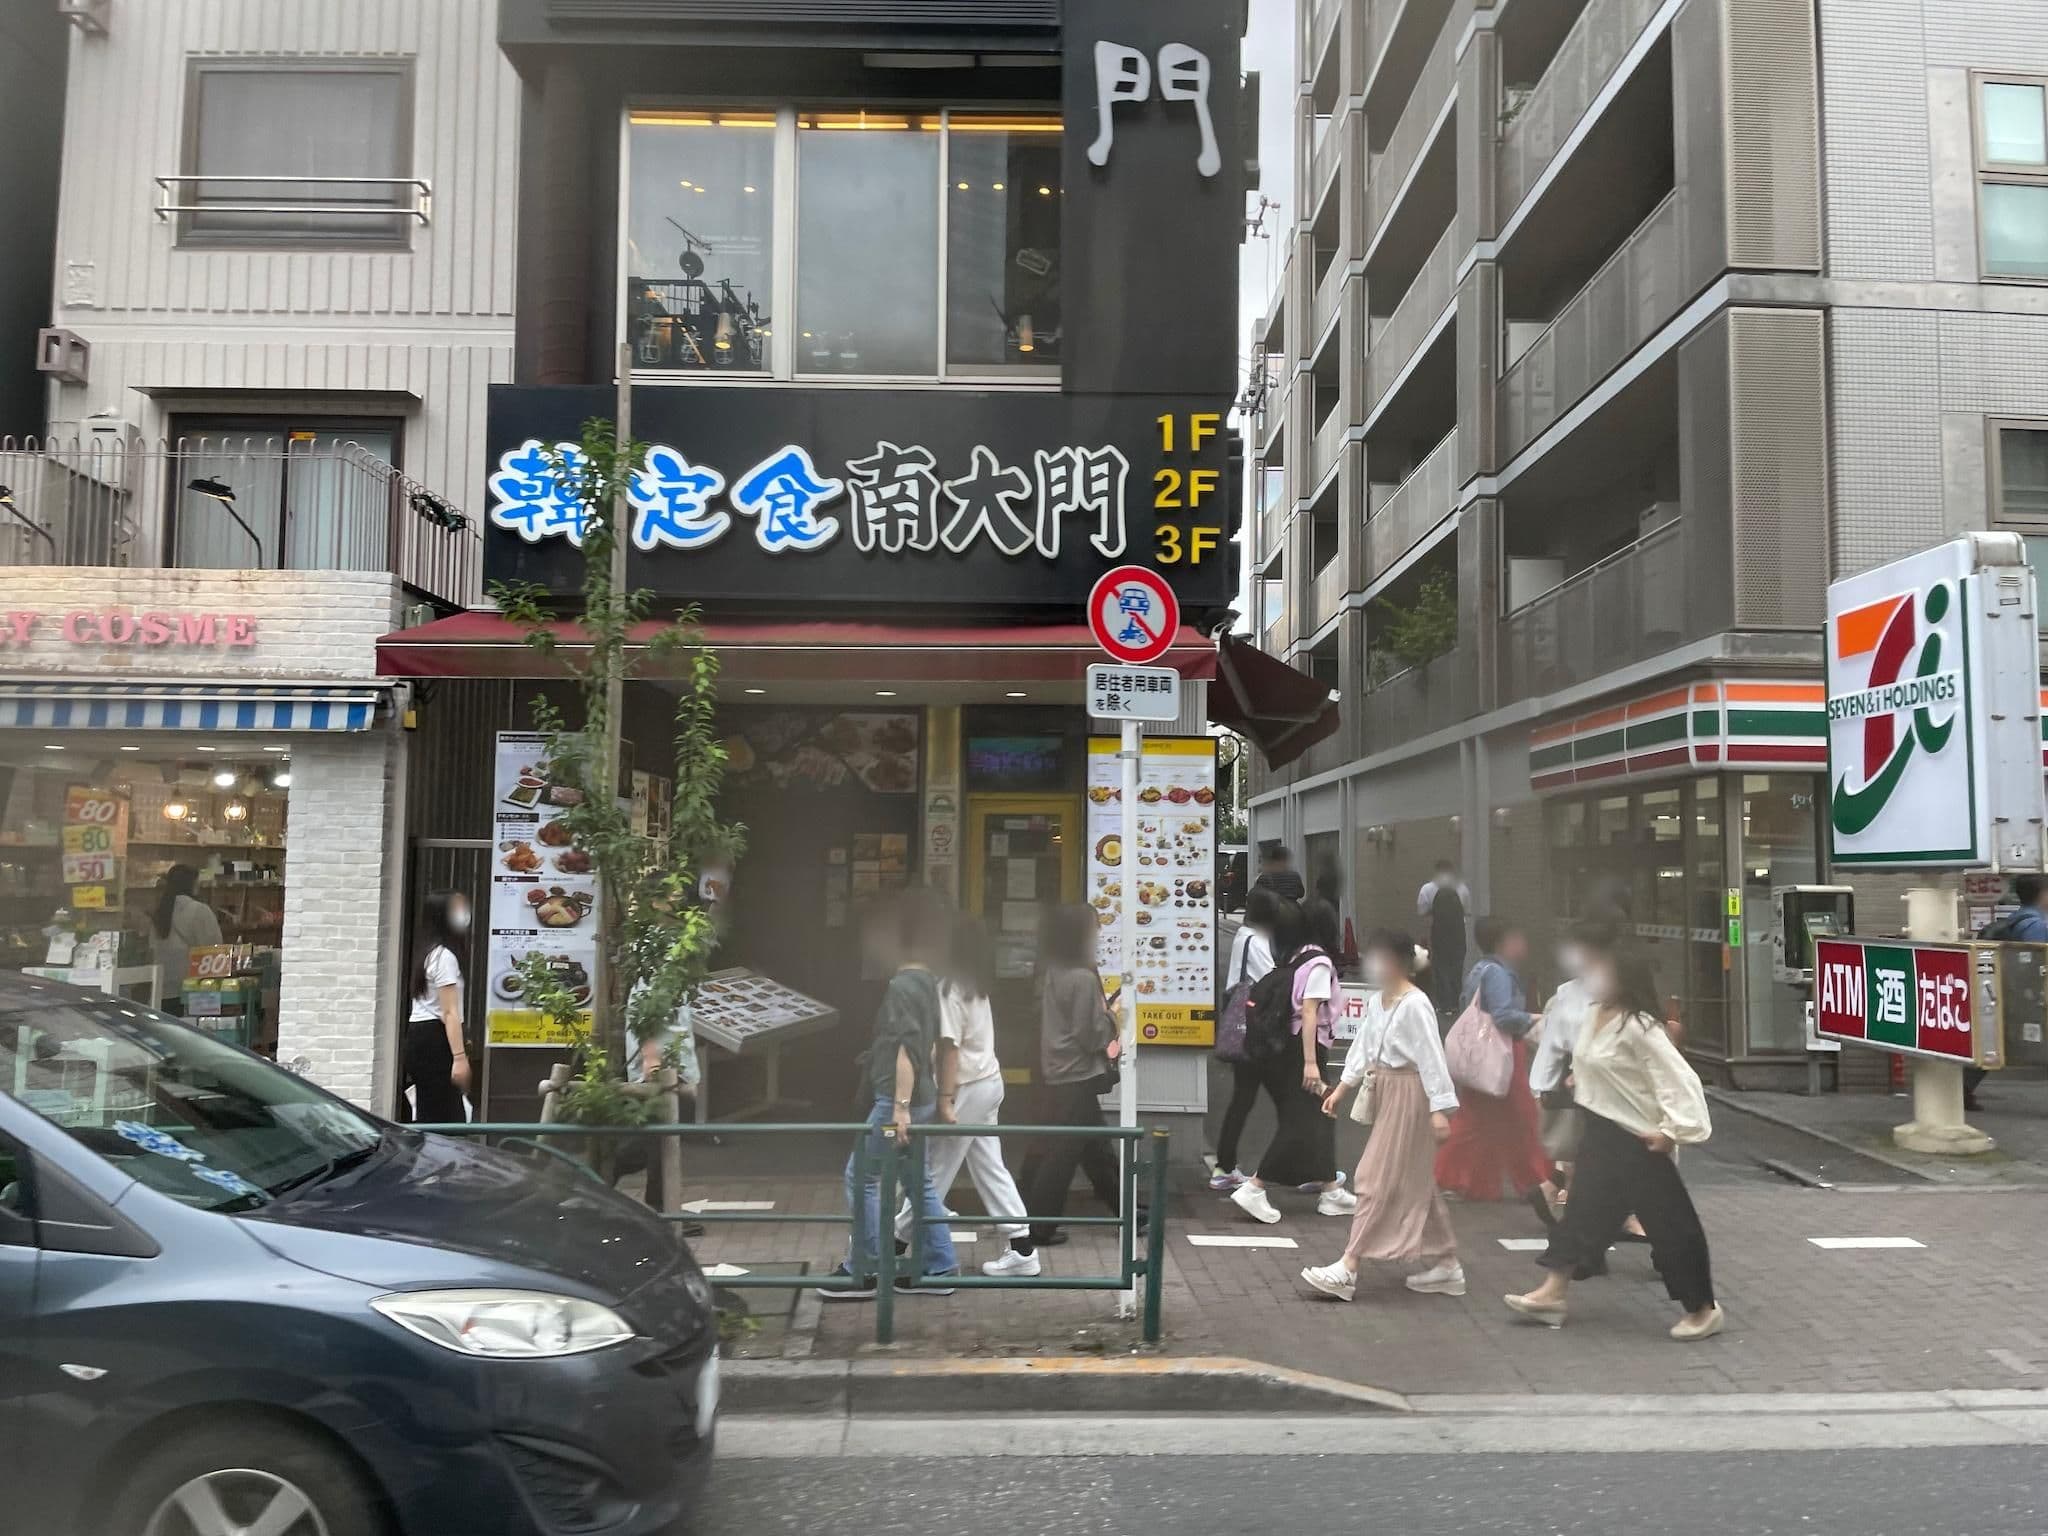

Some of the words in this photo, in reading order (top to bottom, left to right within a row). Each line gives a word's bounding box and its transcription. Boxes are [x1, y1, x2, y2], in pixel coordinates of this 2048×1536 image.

[1087, 40, 1221, 176] 門
[1155, 413, 1220, 452] 1F
[1153, 469, 1220, 508] 2F
[1154, 525, 1221, 564] 3F
[0, 611, 38, 642] Y
[63, 610, 257, 646] COSME
[1095, 673, 1172, 693] 居住者用車両
[1095, 693, 1132, 711] を除く
[1883, 674, 1955, 710] HOLDINGS
[1822, 963, 1863, 1018] ATM
[1875, 967, 1906, 1024] 酒
[1919, 971, 1970, 1032] たばこ
[1142, 1011, 1162, 1020] TAKE
[1166, 1012, 1182, 1020] OUT
